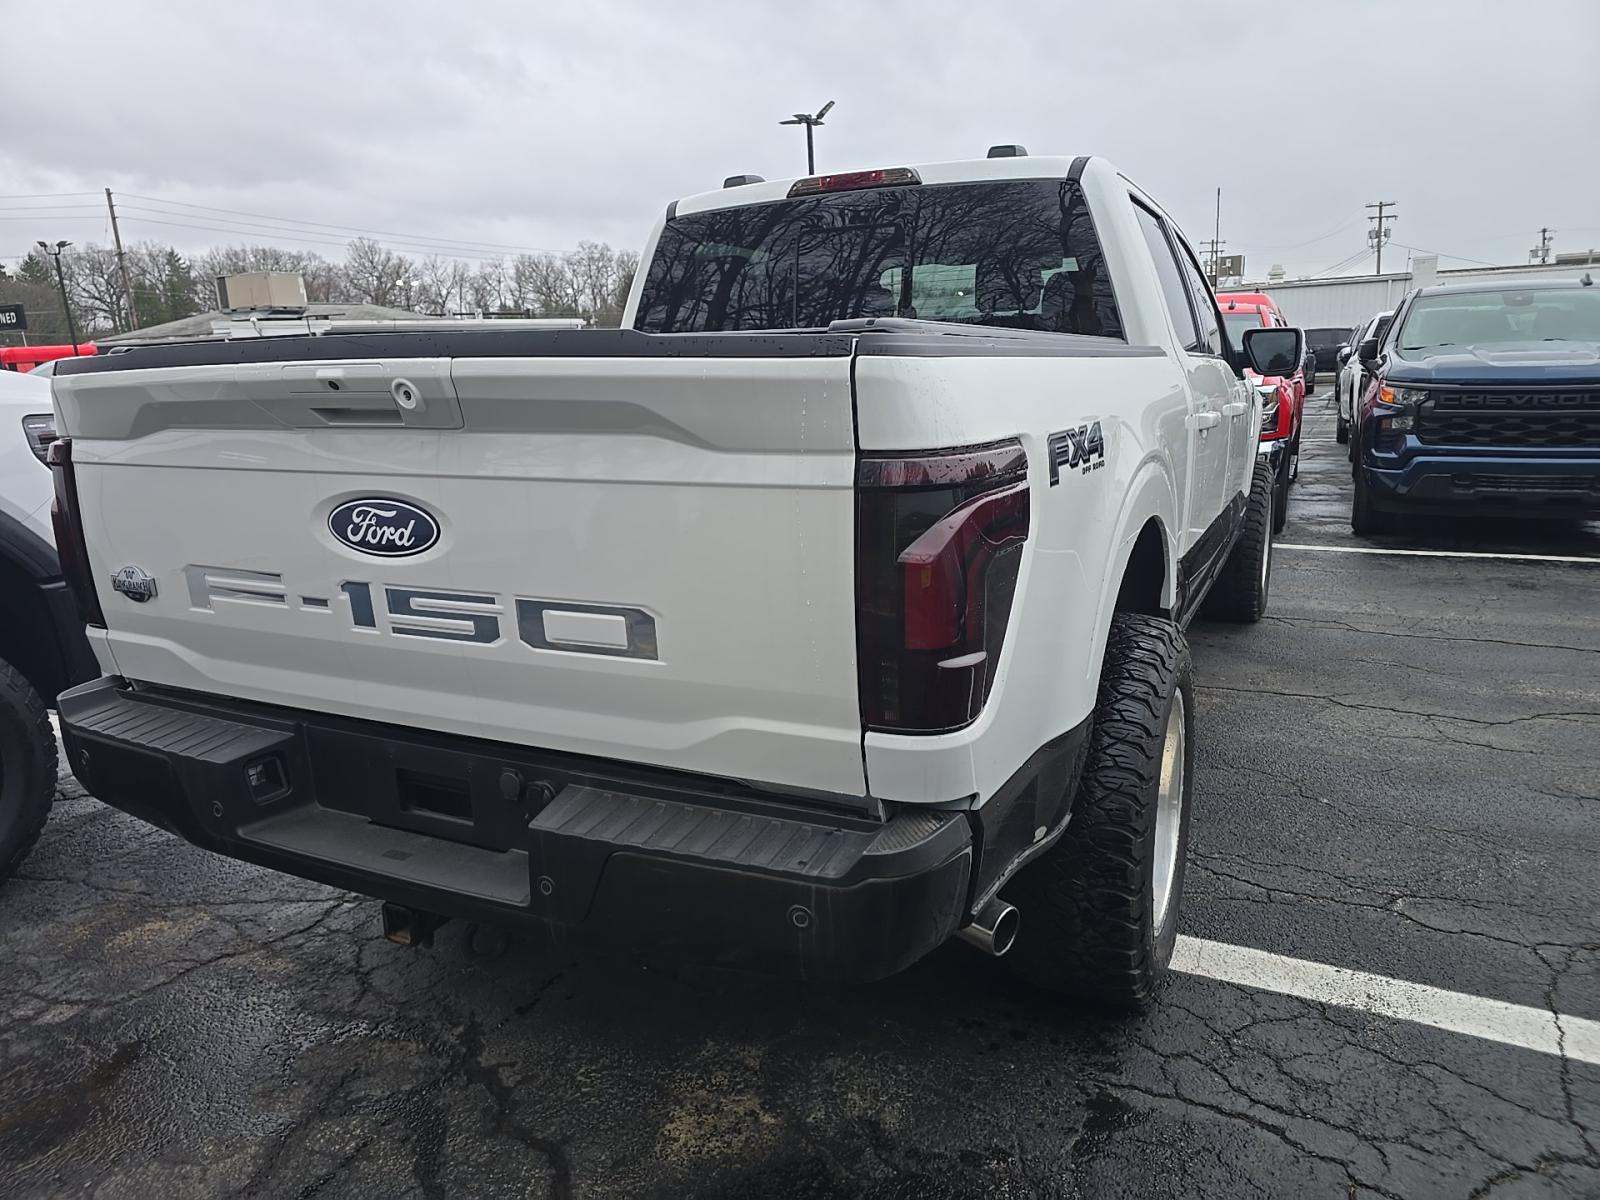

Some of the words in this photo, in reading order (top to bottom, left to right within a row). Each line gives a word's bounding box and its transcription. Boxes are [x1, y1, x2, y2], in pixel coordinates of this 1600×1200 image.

[1047, 420, 1104, 488] FX4
[346, 506, 416, 547] Ford
[184, 563, 662, 661] F-150
